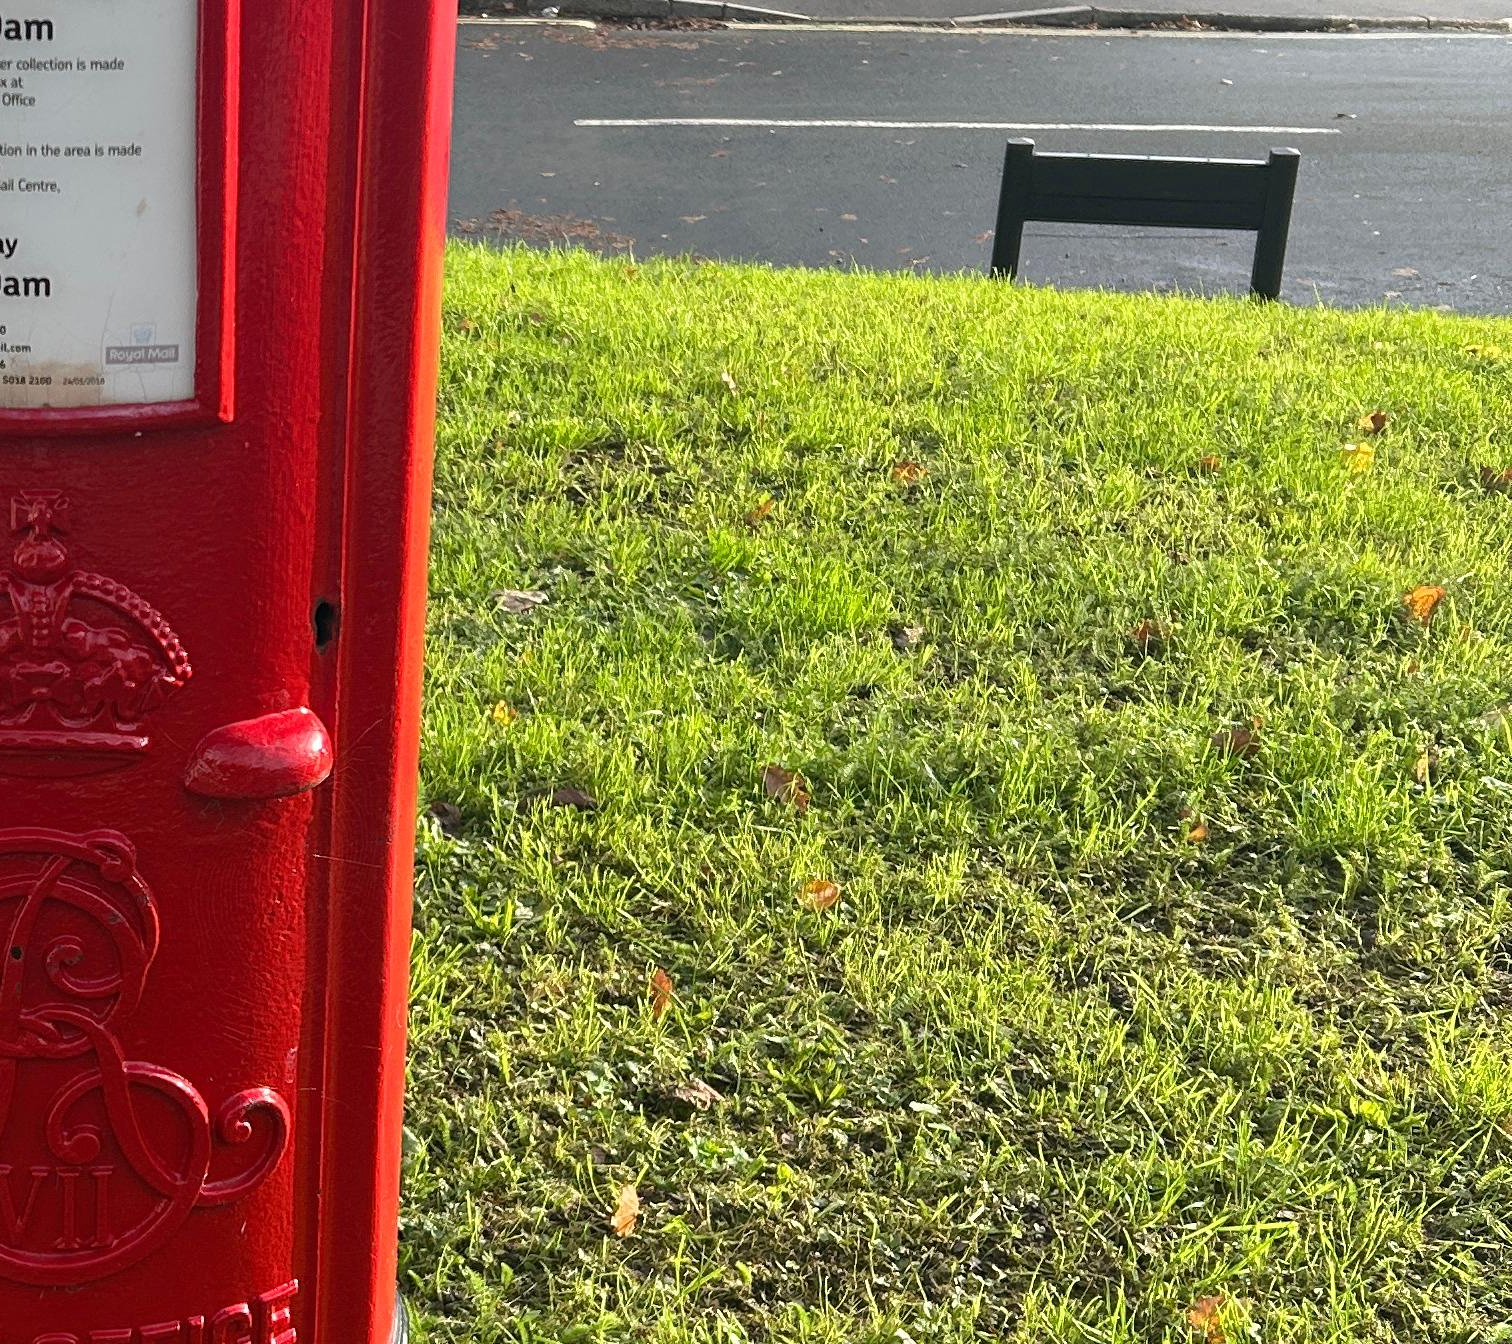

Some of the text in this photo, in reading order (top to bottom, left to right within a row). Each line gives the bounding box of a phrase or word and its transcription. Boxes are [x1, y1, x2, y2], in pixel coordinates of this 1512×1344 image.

[15, 57, 73, 72] collection
[76, 57, 87, 72] is
[90, 57, 125, 71] made
[10, 76, 24, 89] at
[1, 92, 36, 107] Office
[25, 144, 38, 157] in
[40, 143, 61, 158] the
[63, 146, 91, 157] area
[94, 143, 105, 157] is
[107, 143, 142, 157] made
[18, 178, 61, 193] Centre,
[109, 347, 176, 362] Royal Mail
